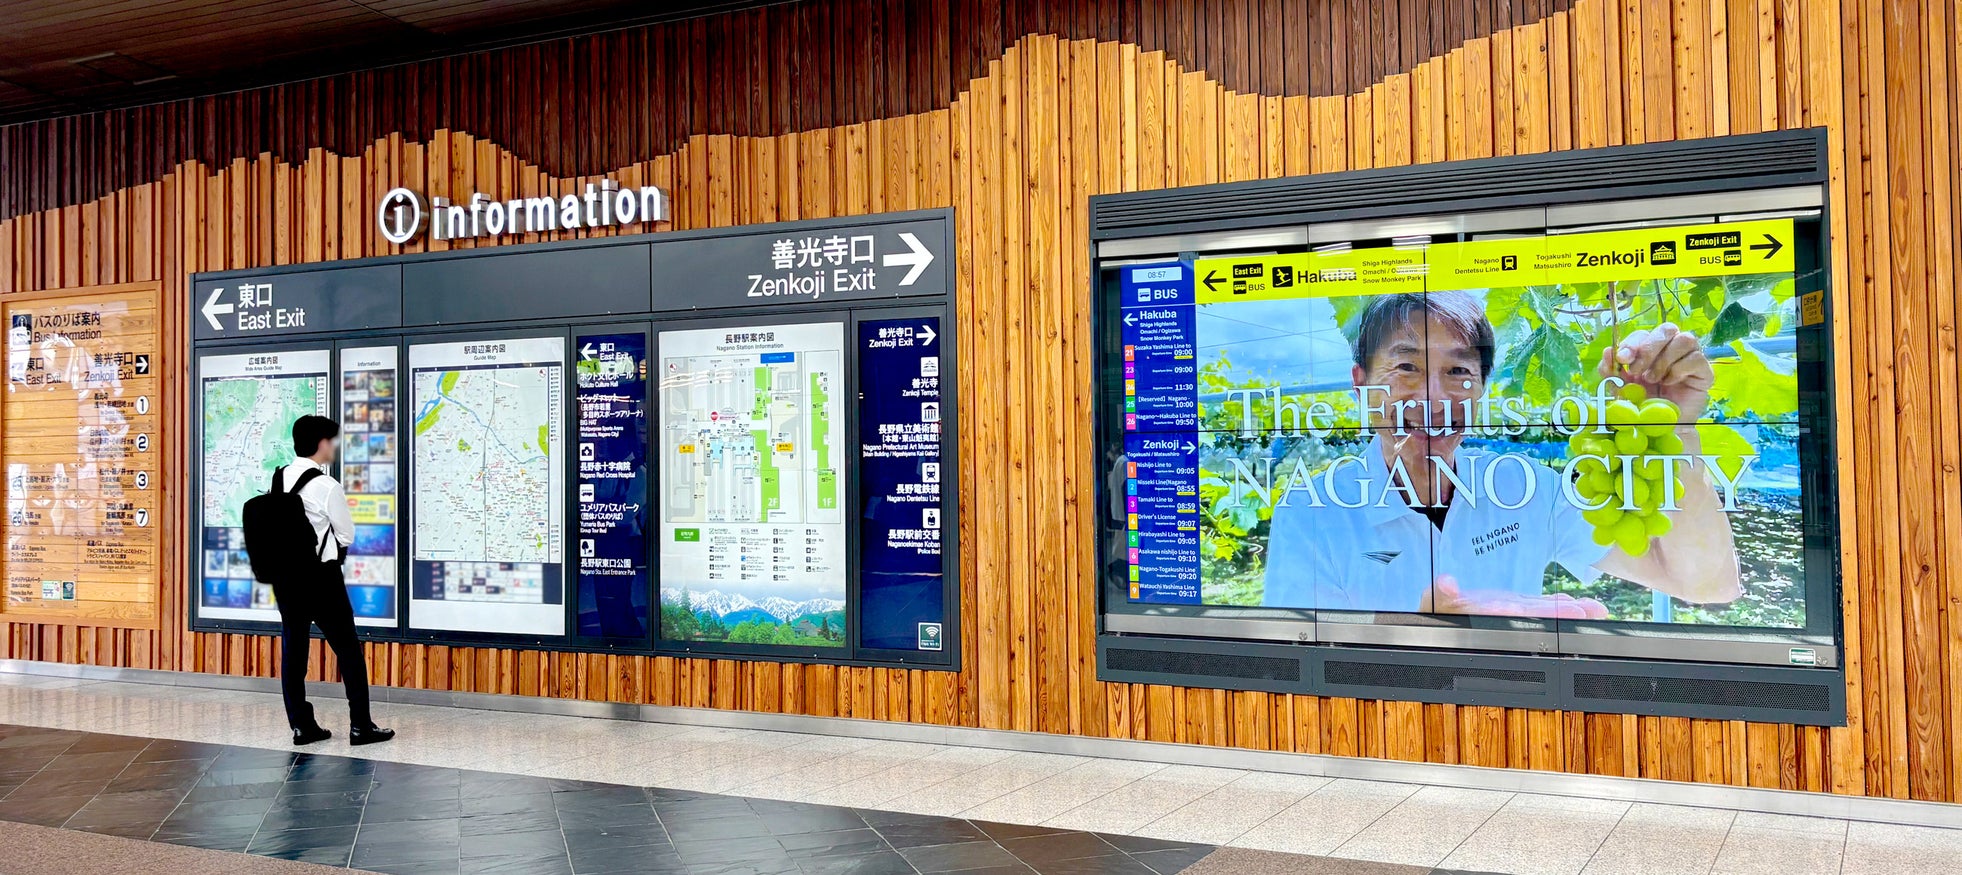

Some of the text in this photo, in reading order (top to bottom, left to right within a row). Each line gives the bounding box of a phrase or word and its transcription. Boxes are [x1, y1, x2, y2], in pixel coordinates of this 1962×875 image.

[433, 180, 661, 239] information
[1689, 234, 1737, 247] Zenkoji Exit
[771, 234, 875, 270] 善光寺口
[1536, 252, 1572, 262] Togakushi
[1362, 258, 1413, 268] Shiga Highlands
[1474, 257, 1500, 266] Nagano
[1576, 248, 1645, 268] Zenkoji
[1699, 255, 1721, 265] BUS
[1234, 266, 1262, 276] East Exit
[1454, 266, 1483, 275] Dentetsu
[1534, 261, 1572, 270] Matsushiro
[1297, 269, 1357, 284] Hakuba
[1381, 276, 1404, 285] Monkey
[747, 268, 876, 299] Zenkoji Exit
[1248, 283, 1265, 292] BUS
[238, 283, 273, 309] 東口
[1154, 289, 1178, 300] BUS
[34, 311, 101, 328] バスのりば案内
[238, 307, 305, 331] East Exit
[1140, 310, 1177, 320] Hakuba
[34, 332, 49, 343] Bus
[725, 332, 775, 344] 長野駅案内図
[879, 327, 913, 338] 善光寺口
[600, 343, 614, 352] 東口
[869, 338, 913, 348] Zenkoji Exit
[464, 344, 506, 354] 駅周辺案内図
[27, 358, 44, 371] 東口
[94, 352, 133, 367] 善光寺口
[26, 374, 44, 385] East
[84, 369, 133, 382] Zenkoji Exit
[912, 378, 938, 389] 善光寺
[140, 398, 145, 411] 1
[1227, 376, 1628, 440] The Fruits of
[138, 436, 146, 449] 2
[1143, 439, 1179, 451] Zenkoji
[138, 473, 146, 486] 3
[1227, 453, 1758, 512] NAGANO CITY
[768, 497, 778, 507] 2F
[822, 497, 832, 506] 1F
[138, 511, 146, 524] 7
